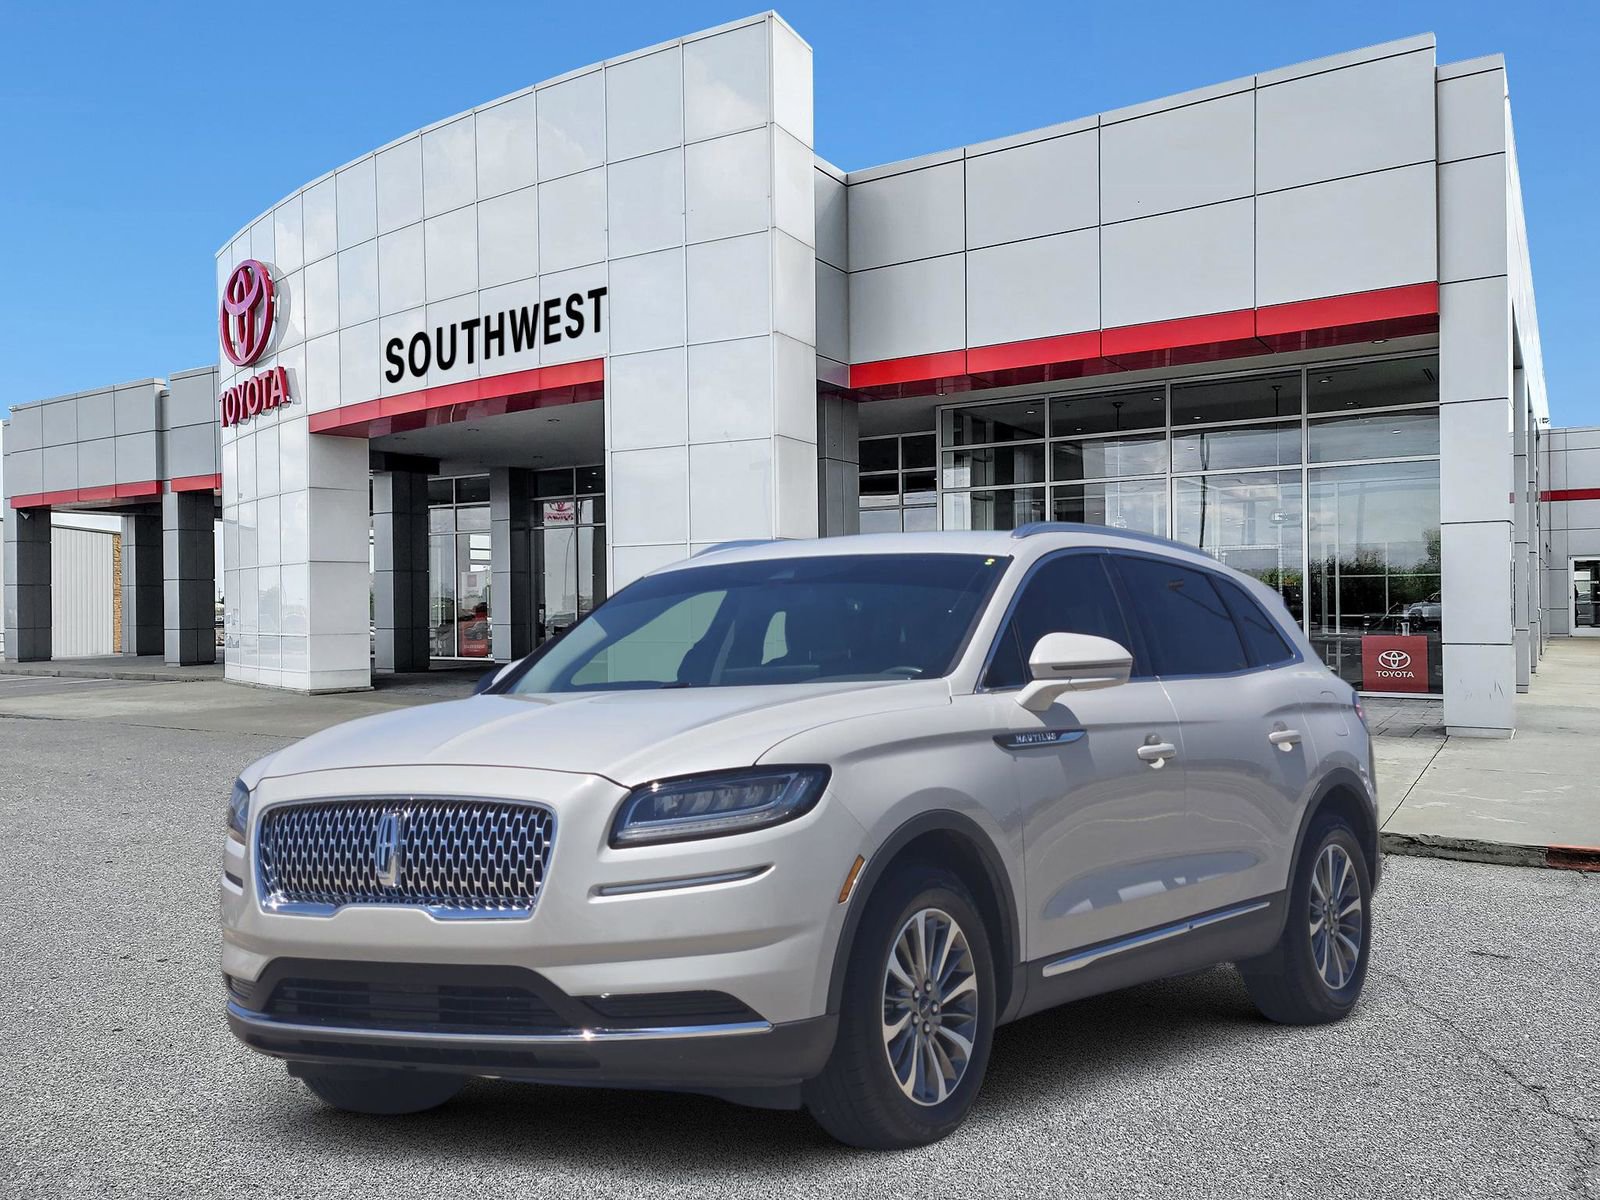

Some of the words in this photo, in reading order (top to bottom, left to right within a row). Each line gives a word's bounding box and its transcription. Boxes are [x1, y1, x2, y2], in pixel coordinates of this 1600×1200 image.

[385, 286, 607, 383] SOUTHWEST
[219, 366, 290, 428] TOYOTA
[1375, 670, 1415, 678] TOYOTA
[1015, 732, 1057, 743] NAUTILUS
